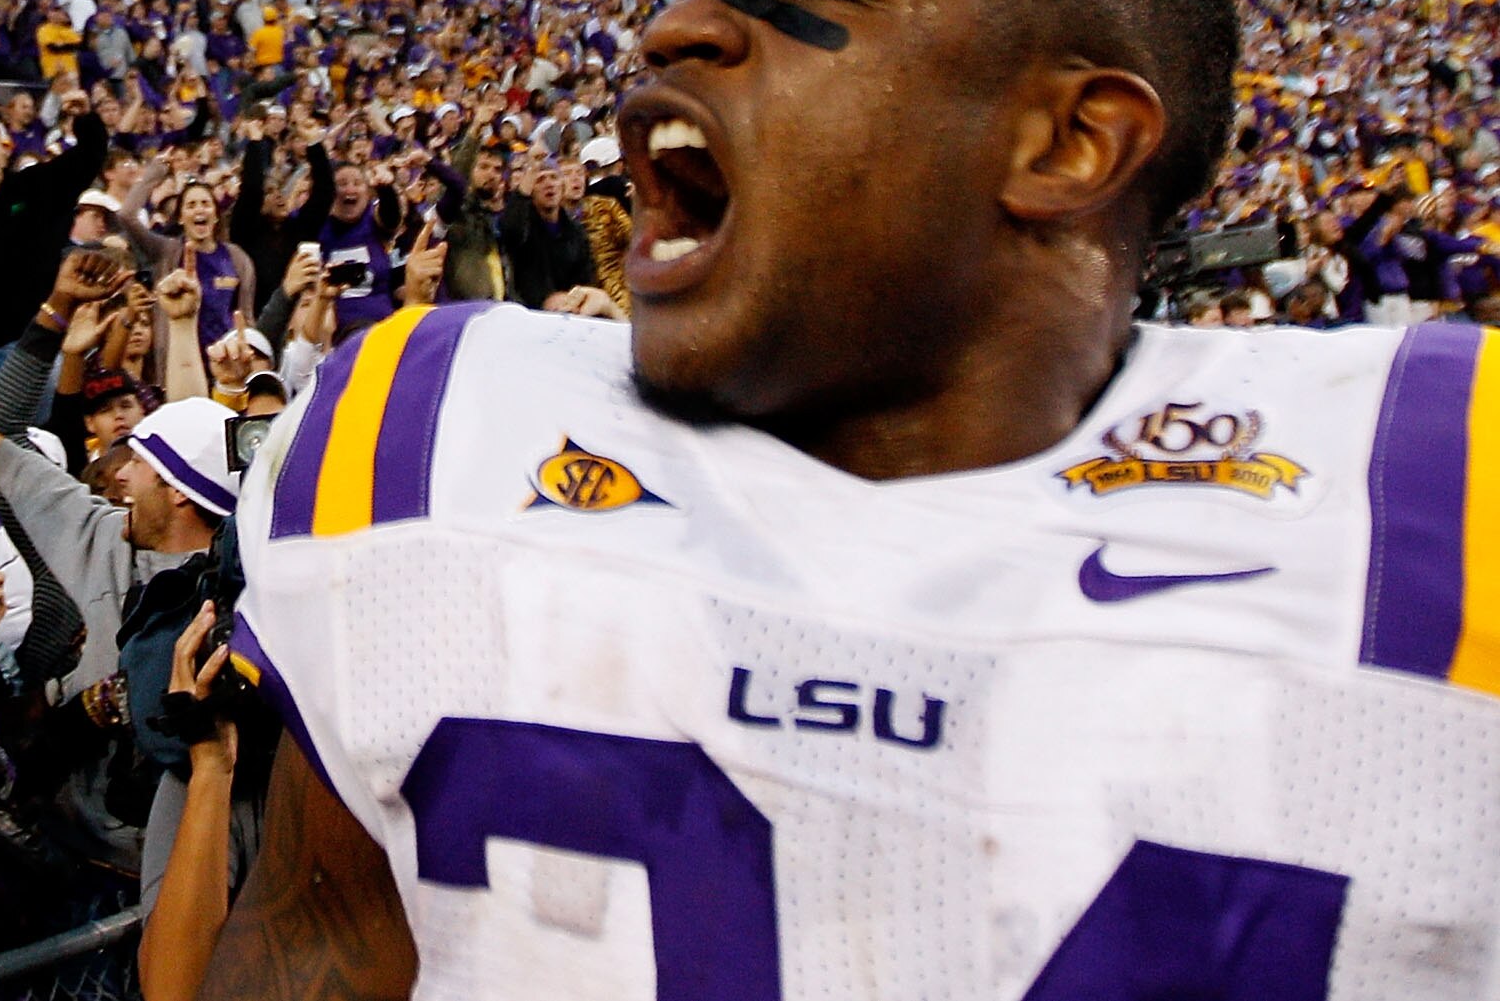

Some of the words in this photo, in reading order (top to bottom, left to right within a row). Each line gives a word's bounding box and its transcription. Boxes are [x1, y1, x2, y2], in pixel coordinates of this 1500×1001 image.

[1139, 401, 1239, 452] 150
[557, 458, 616, 508] SEC
[1142, 463, 1217, 483] LSU
[727, 667, 946, 749] LSU
